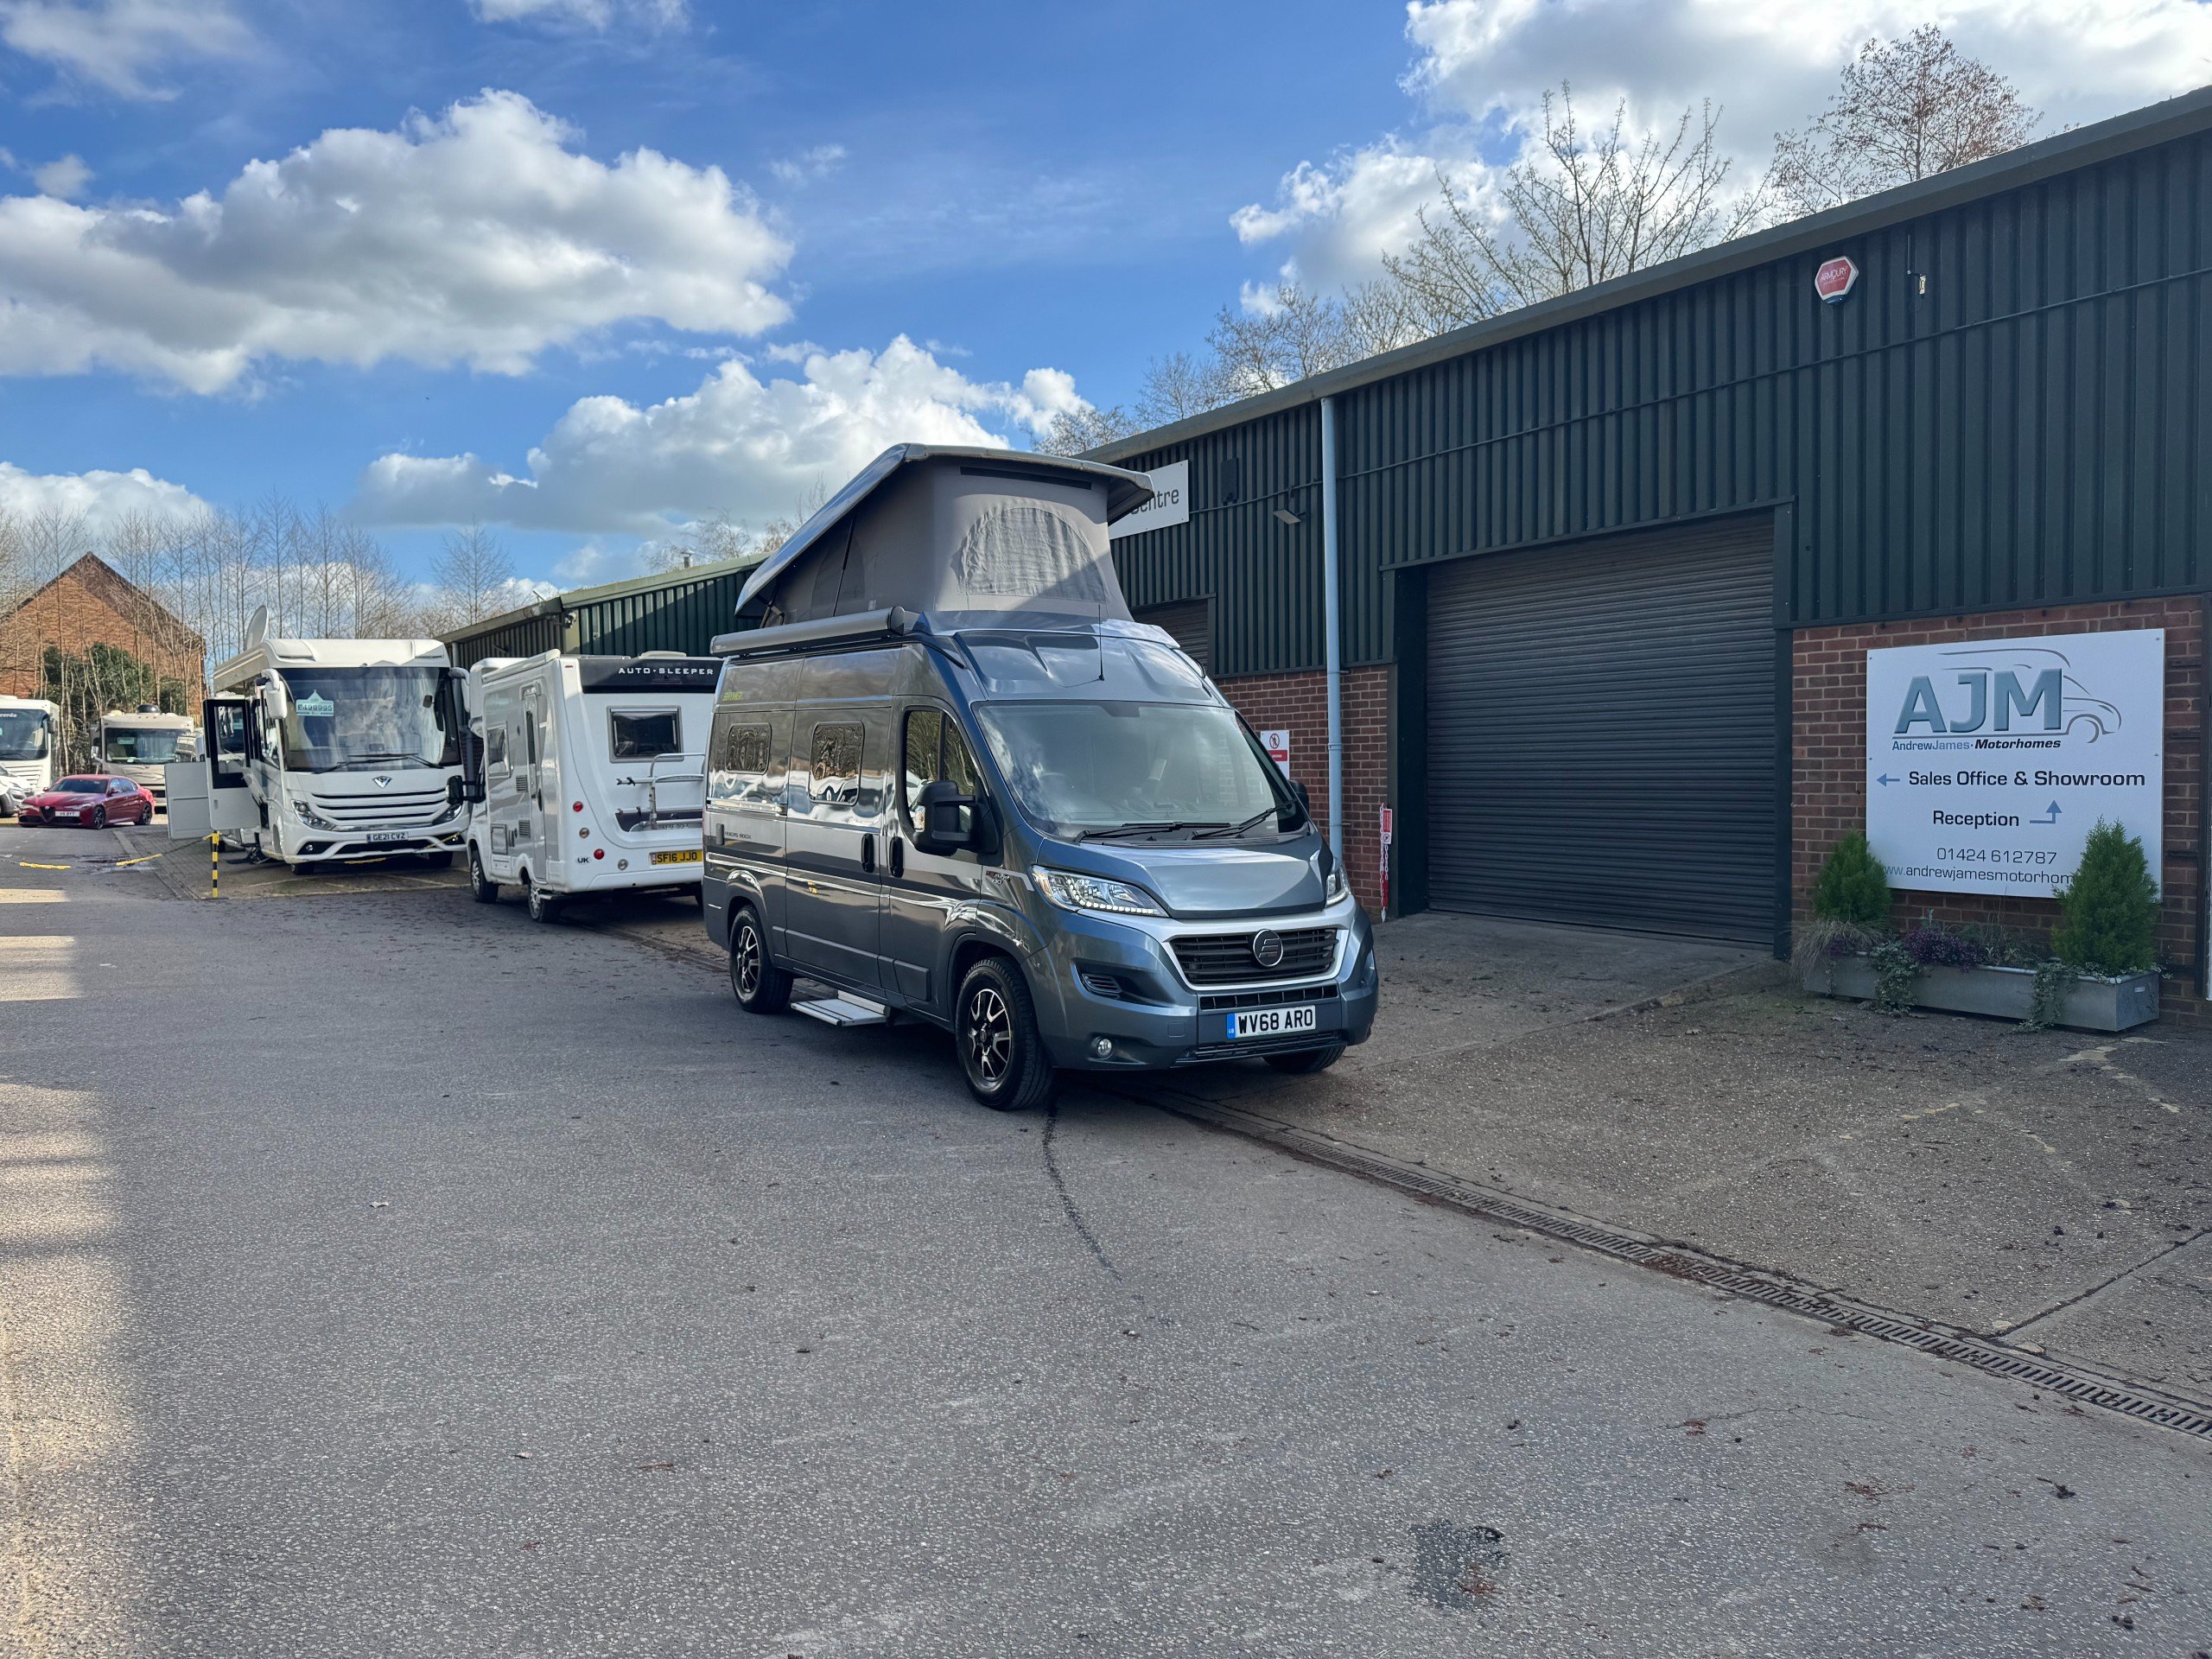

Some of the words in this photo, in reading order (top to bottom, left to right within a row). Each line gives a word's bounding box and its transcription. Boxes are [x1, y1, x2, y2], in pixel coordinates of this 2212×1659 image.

[1894, 668, 2063, 734] AJM
[1909, 771, 1952, 785] Sales
[1956, 771, 2008, 785] Office
[2013, 771, 2028, 785] &
[2034, 770, 2146, 786] Showroom
[1932, 810, 2019, 830] Reception
[657, 853, 677, 863] SF16
[1936, 848, 1986, 862] 01424
[1991, 849, 2057, 865] 612787
[1238, 1013, 1279, 1034] WV68
[1285, 1009, 1313, 1029] ARO
